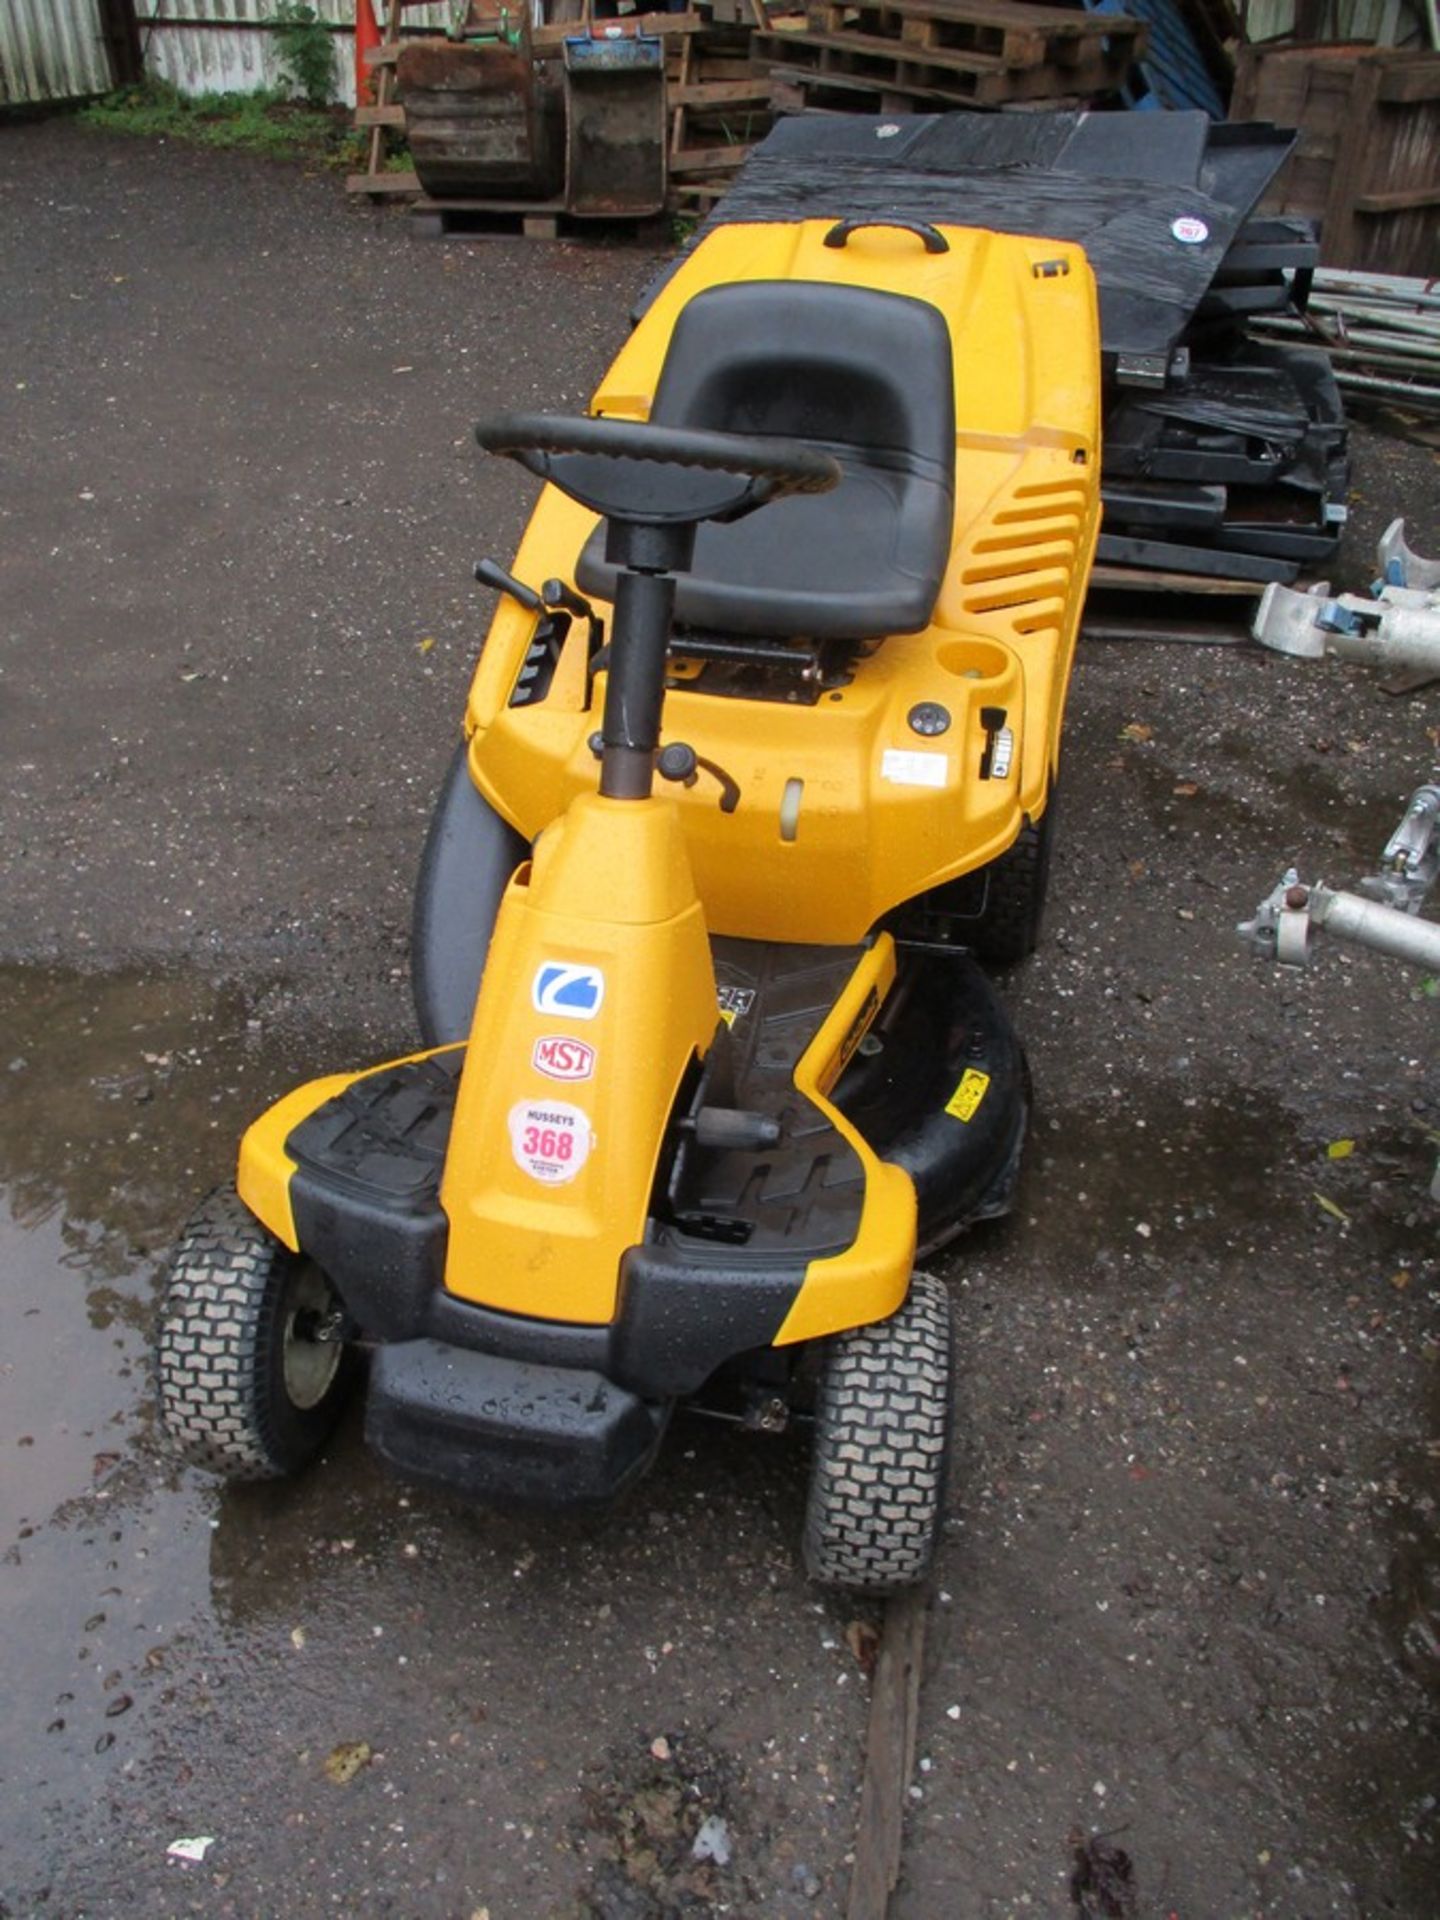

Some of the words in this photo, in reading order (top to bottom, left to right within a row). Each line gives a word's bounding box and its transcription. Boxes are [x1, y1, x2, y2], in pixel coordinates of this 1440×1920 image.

[540, 1042, 590, 1071] MST
[527, 1110, 575, 1126] HUSSEYS
[522, 1125, 574, 1161] 368
